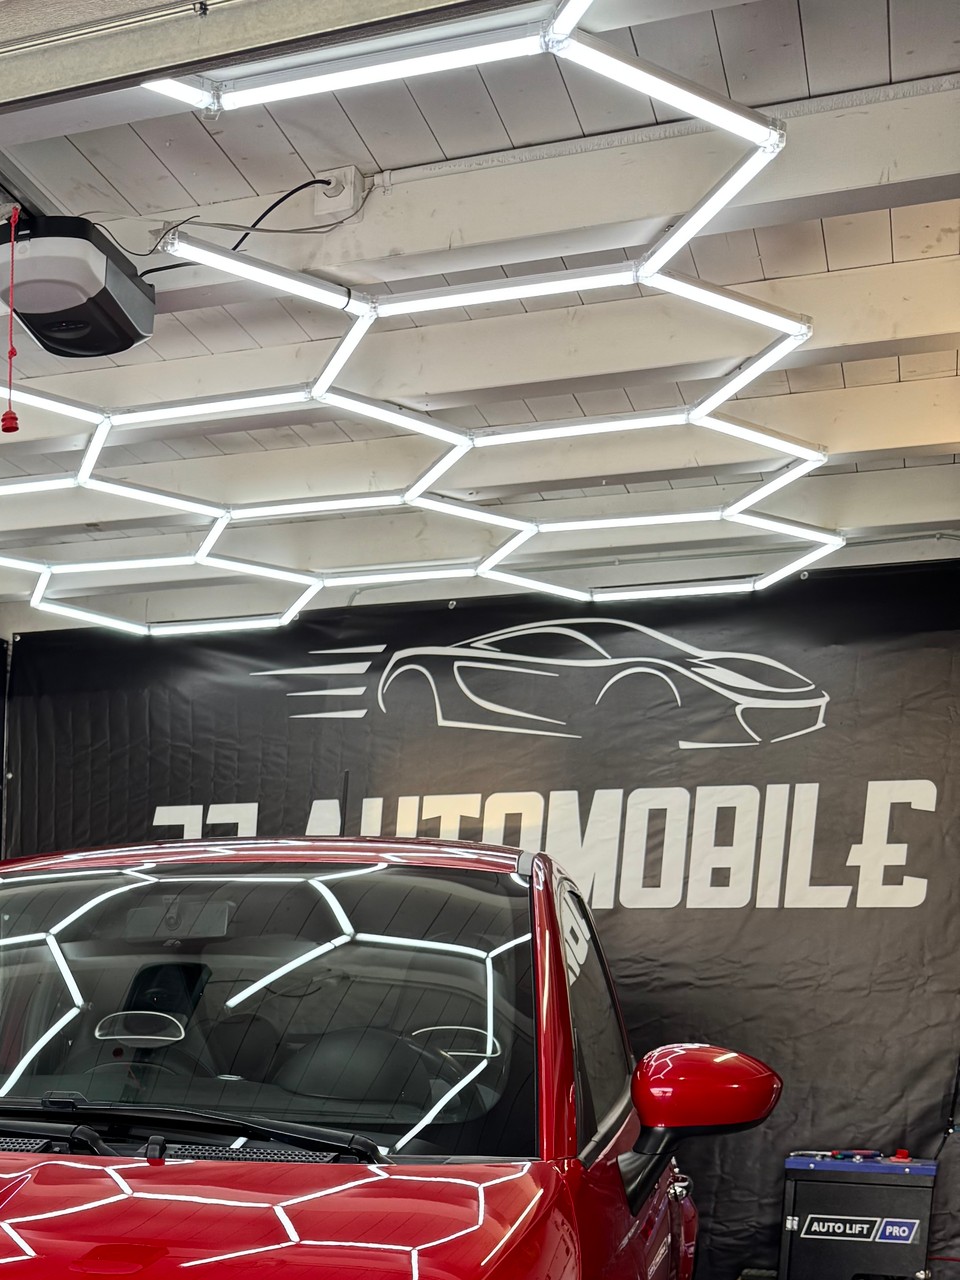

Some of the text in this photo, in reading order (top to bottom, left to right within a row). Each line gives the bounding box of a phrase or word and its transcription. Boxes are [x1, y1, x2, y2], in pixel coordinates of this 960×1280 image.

[811, 1221, 909, 1237] AUTO LIFT PRO
